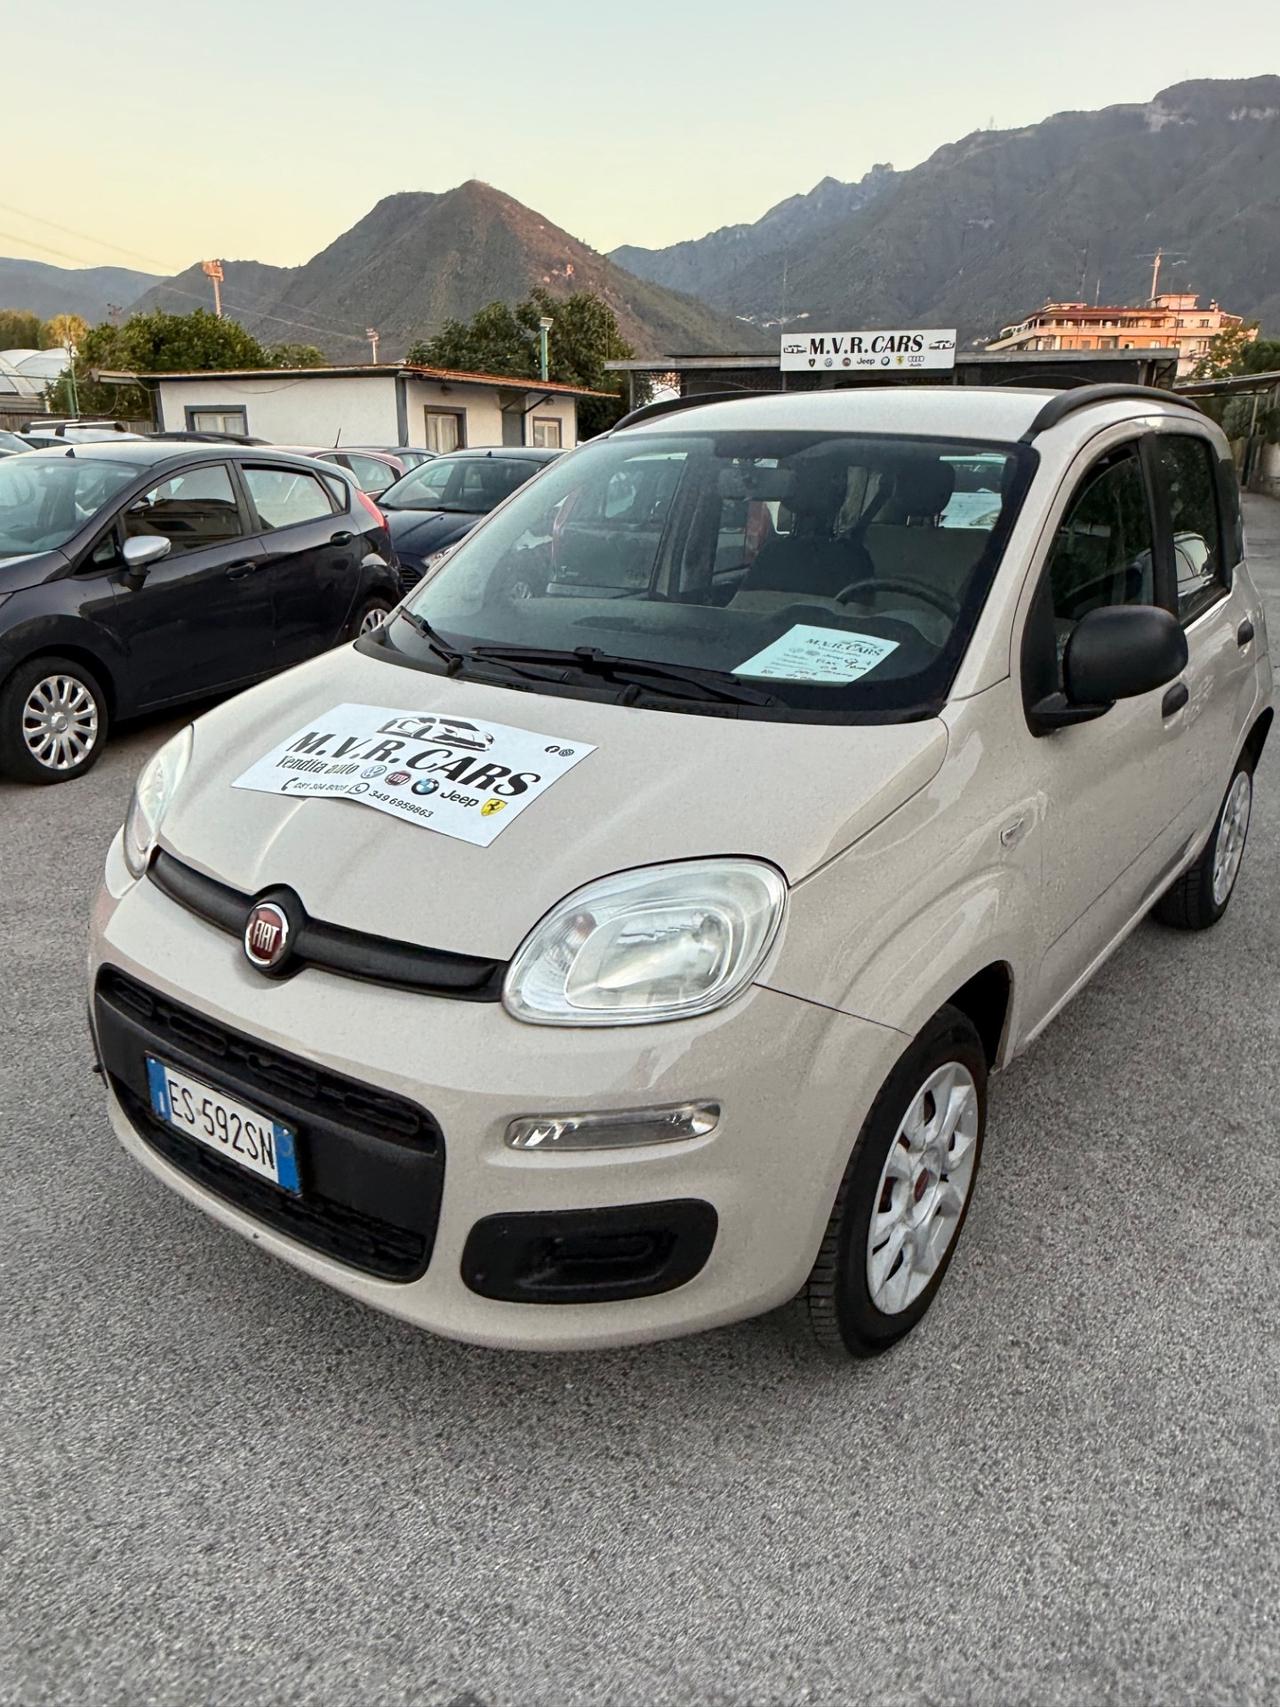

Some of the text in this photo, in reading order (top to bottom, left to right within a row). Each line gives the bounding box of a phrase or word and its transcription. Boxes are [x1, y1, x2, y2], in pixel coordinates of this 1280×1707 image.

[857, 357, 876, 366] Jeep
[275, 755, 360, 775] Vendita auto
[368, 790, 434, 818] 349 6959863
[440, 790, 479, 807] Jeep
[252, 919, 280, 952] FIAT
[168, 1079, 195, 1125] ES
[201, 1098, 275, 1170] 592SN
